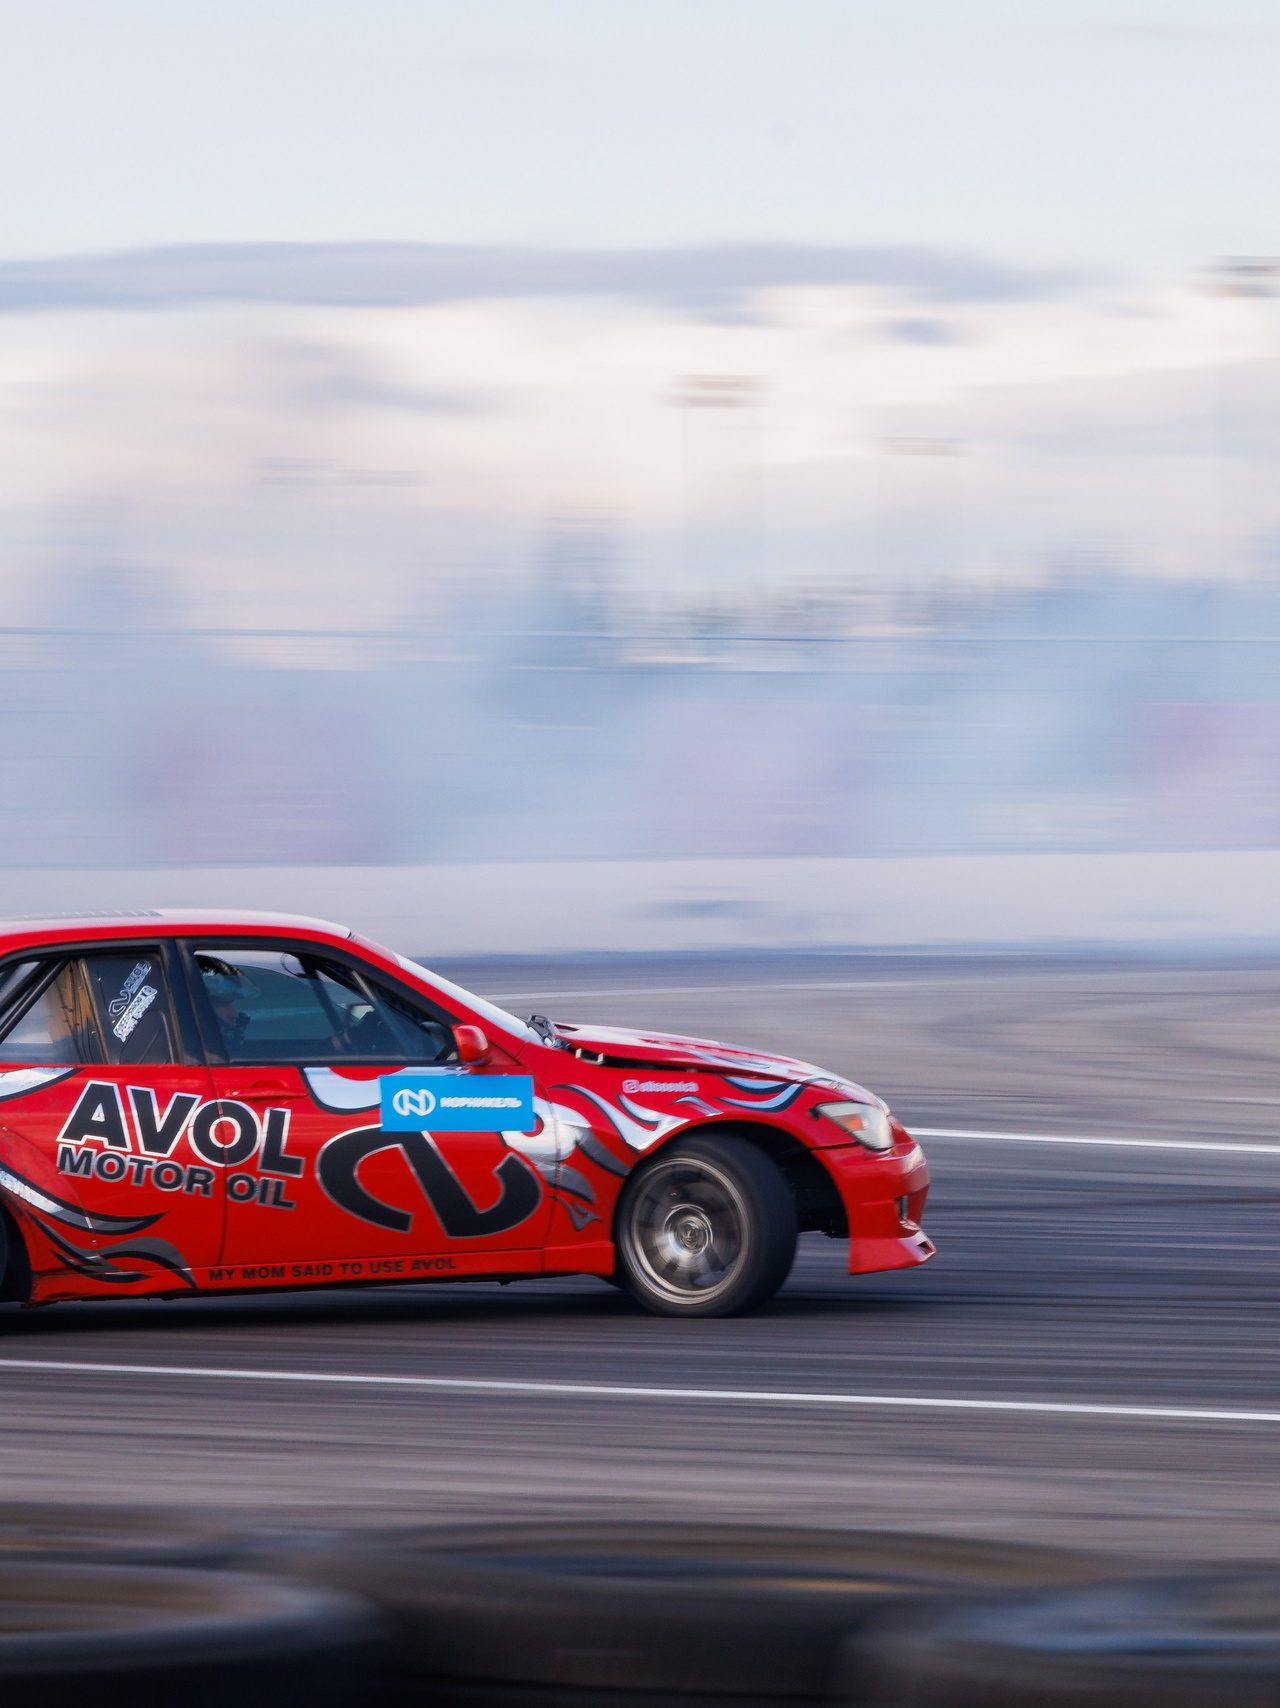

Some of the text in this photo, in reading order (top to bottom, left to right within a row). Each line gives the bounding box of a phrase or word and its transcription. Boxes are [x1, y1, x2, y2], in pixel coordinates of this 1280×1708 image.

[56, 1080, 304, 1178] AVOL
[57, 1143, 297, 1211] MOTOR OIL
[209, 1257, 458, 1281] MY MOM SAID TO USE AVOL
